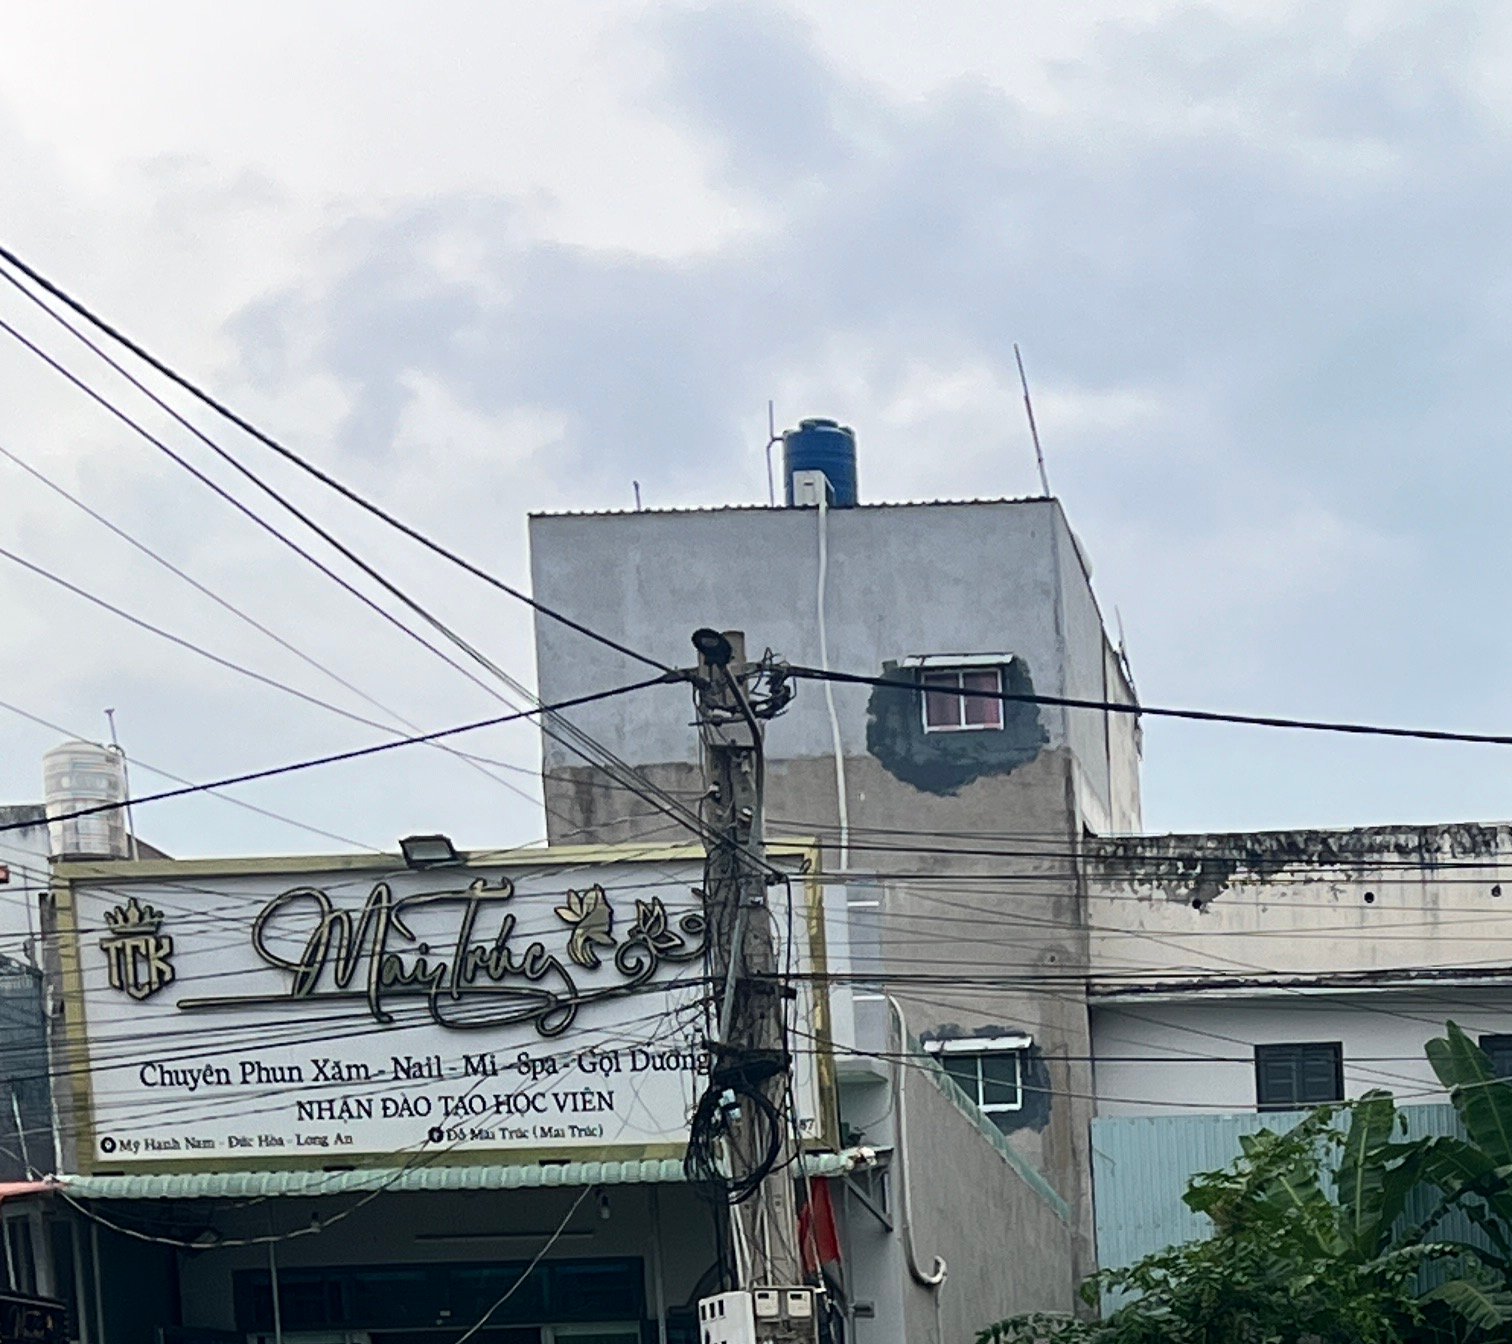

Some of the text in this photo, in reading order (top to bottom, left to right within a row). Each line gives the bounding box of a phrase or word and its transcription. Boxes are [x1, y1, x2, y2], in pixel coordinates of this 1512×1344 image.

[139, 1062, 232, 1091] Chuyên
[239, 1060, 304, 1085] Phun
[311, 1057, 371, 1081] Xăm
[391, 1053, 444, 1080] Nail
[463, 1053, 498, 1077] Mi
[517, 1051, 559, 1081] Spa
[381, 1092, 432, 1118] ĐÀO
[438, 1092, 487, 1119] TẠO
[493, 1090, 548, 1118] HỌC
[552, 1086, 615, 1113] VIÊN
[295, 1132, 329, 1147] Long
[334, 1132, 354, 1145] An
